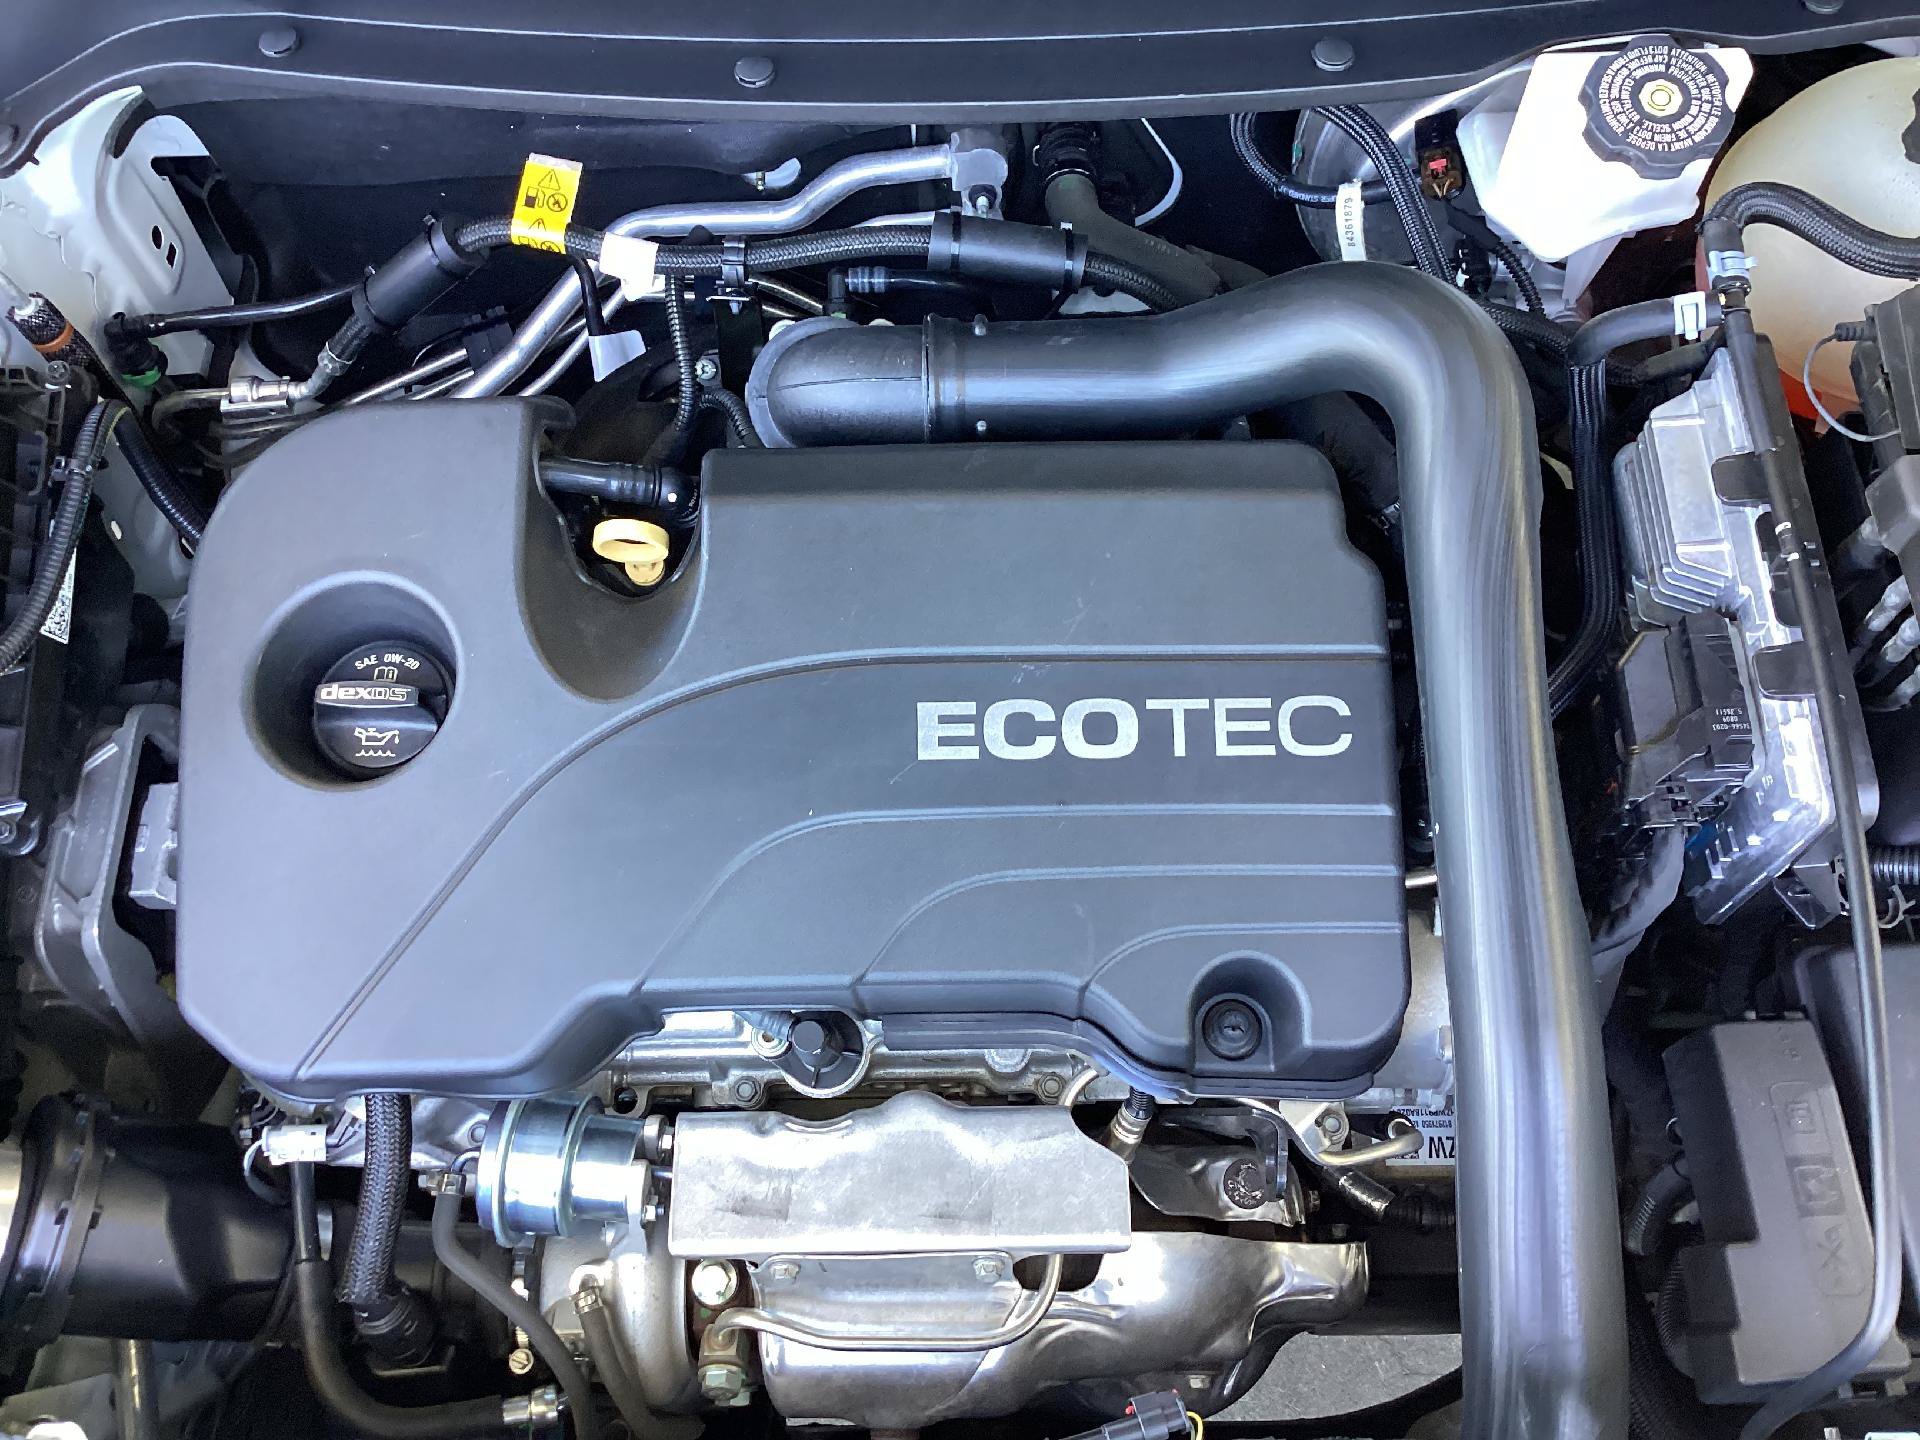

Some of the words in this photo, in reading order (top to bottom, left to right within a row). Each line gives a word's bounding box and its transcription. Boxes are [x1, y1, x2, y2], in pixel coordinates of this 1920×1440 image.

[1625, 55, 1653, 71] BEFORE
[1654, 55, 1668, 64] CAP
[1711, 107, 1722, 117] LE
[1657, 142, 1669, 152] LA
[355, 654, 378, 670] SAE
[384, 653, 420, 670] 0W-20
[917, 695, 1353, 760] ECOTEC
